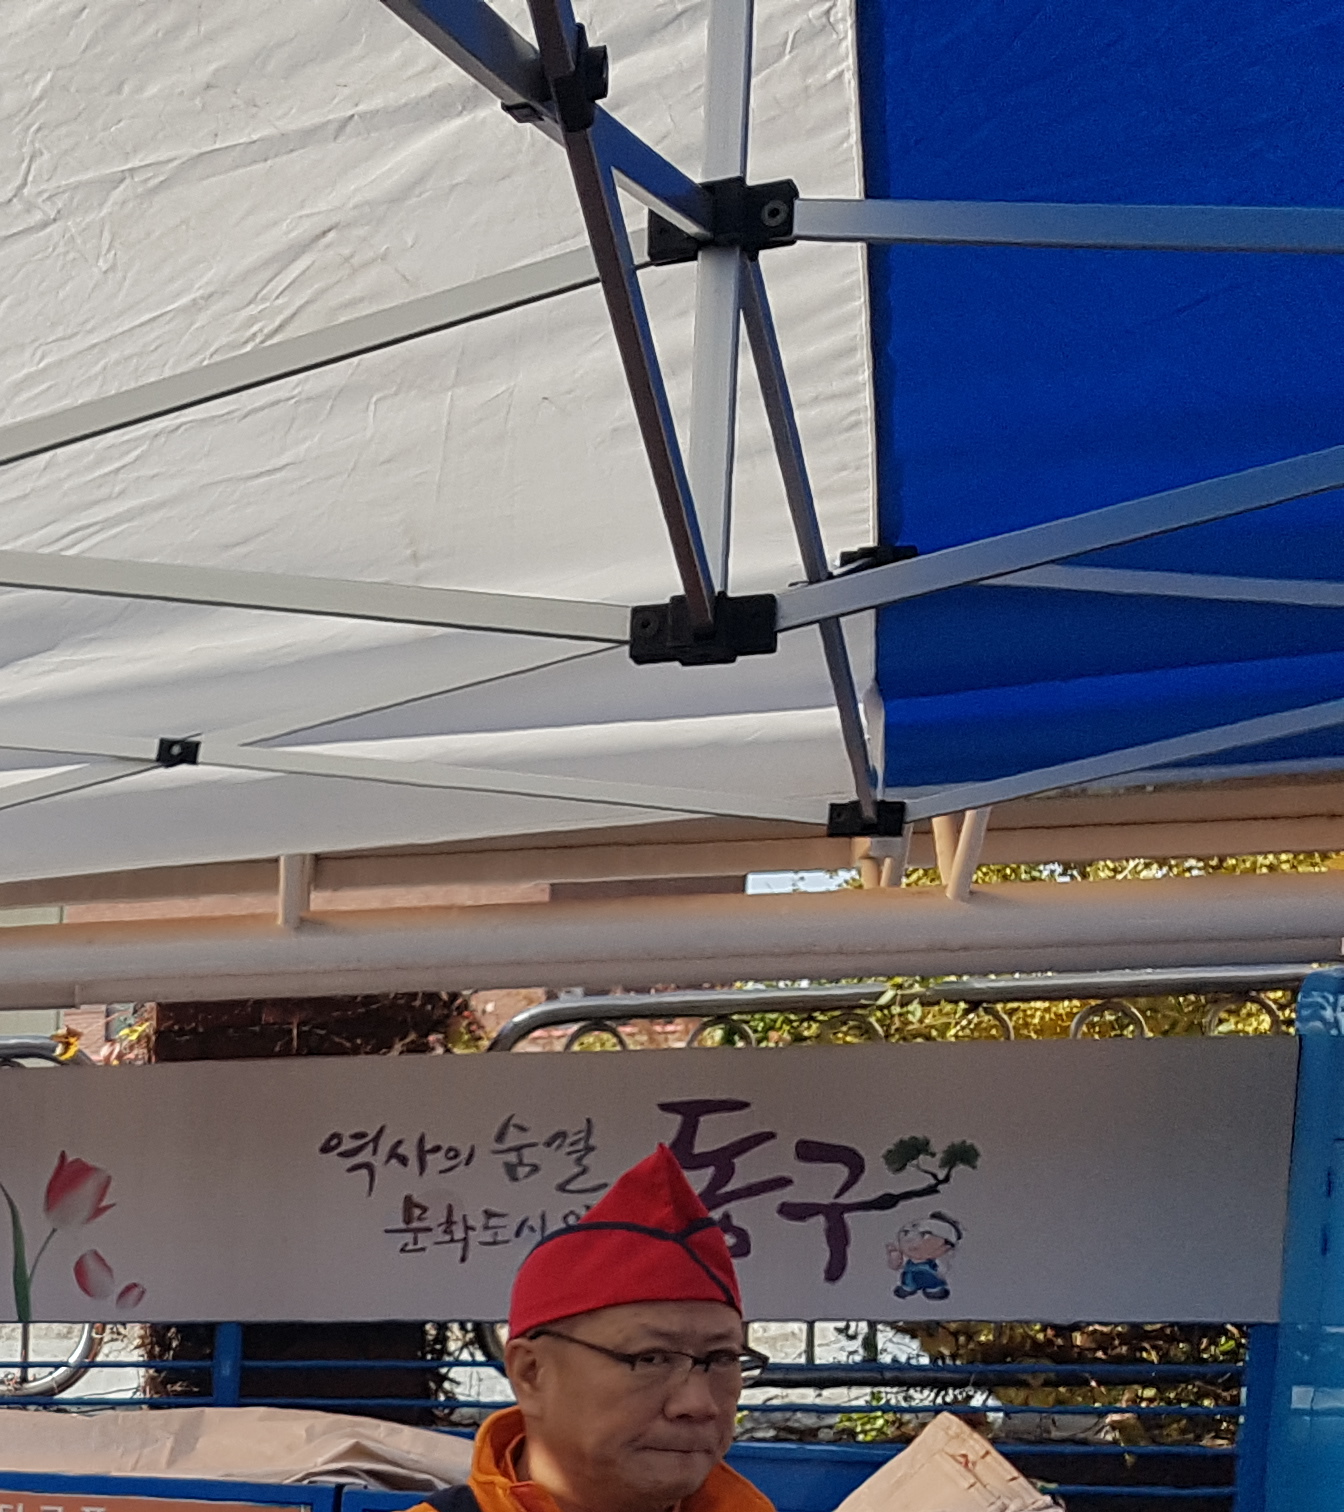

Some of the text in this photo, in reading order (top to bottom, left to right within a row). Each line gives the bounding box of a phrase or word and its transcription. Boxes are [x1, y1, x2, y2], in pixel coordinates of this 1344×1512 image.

[319, 1113, 609, 1197] 역사의 숨결
[657, 1098, 867, 1282] 동구
[384, 1194, 547, 1263] 문화도시
